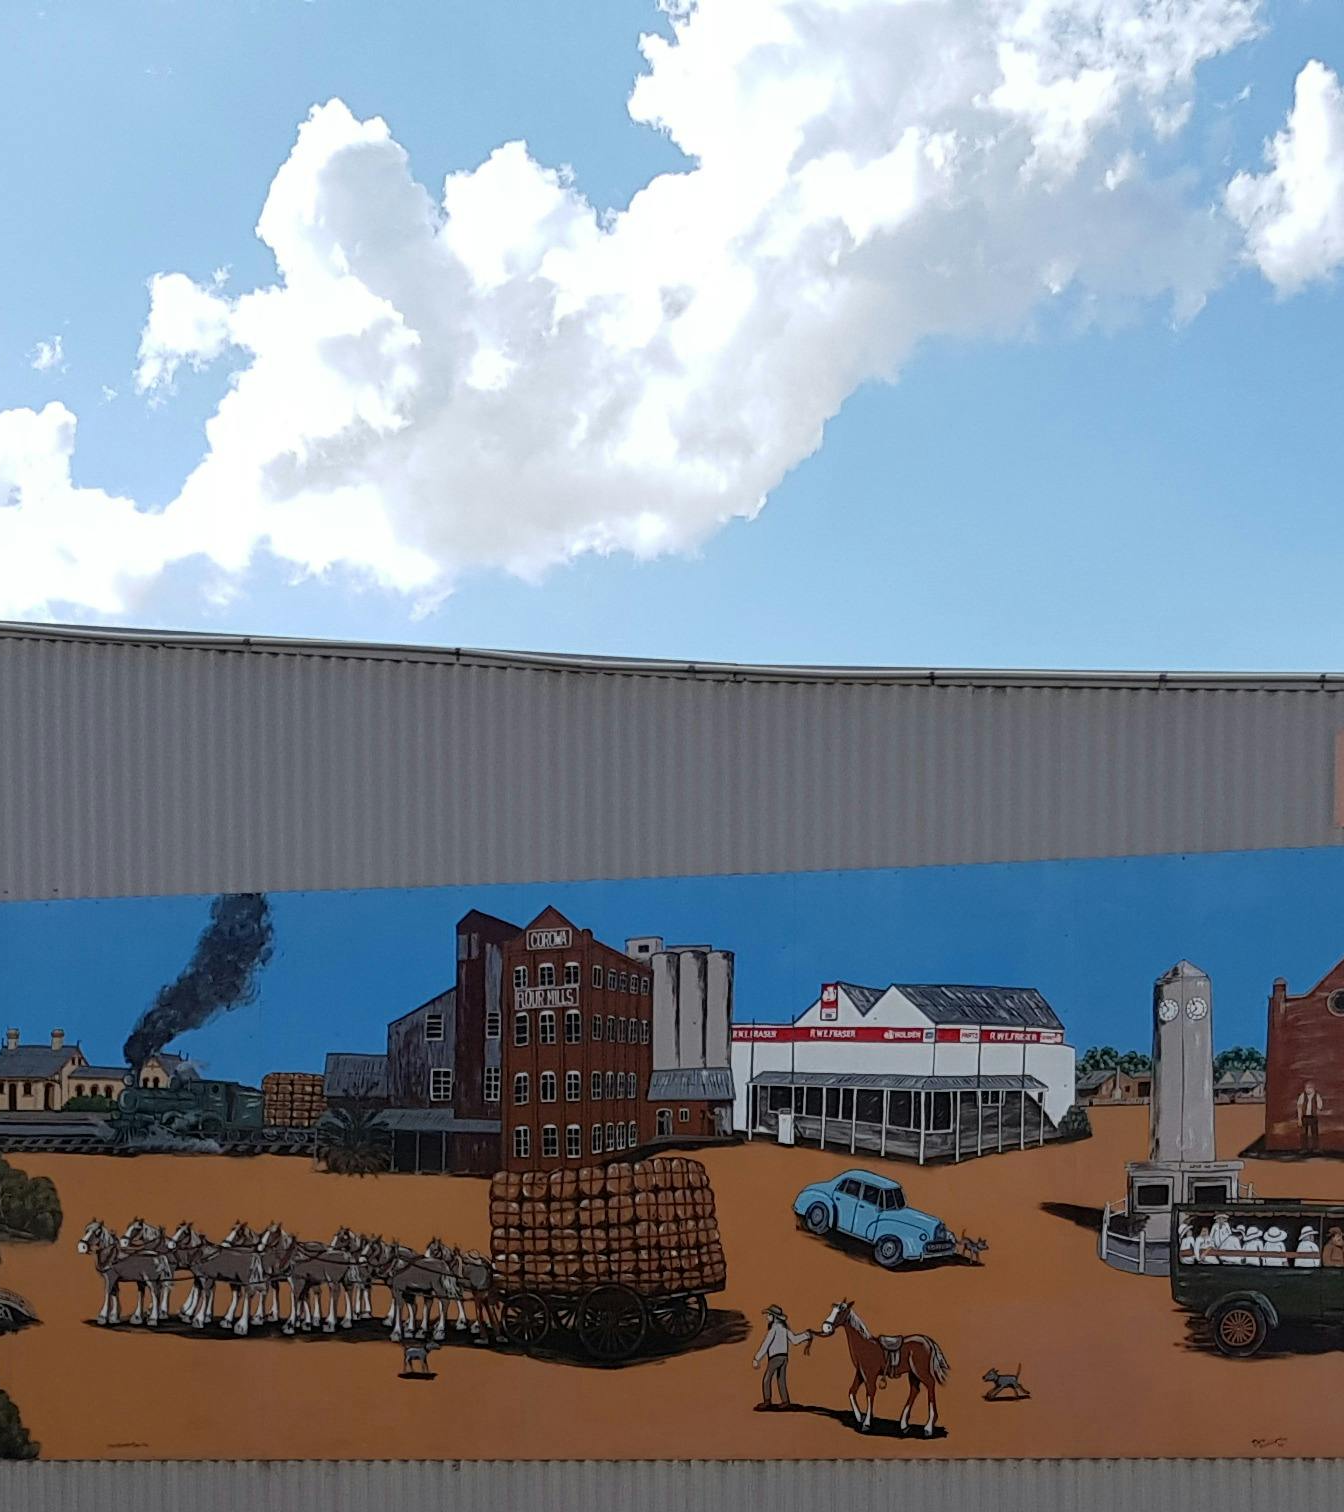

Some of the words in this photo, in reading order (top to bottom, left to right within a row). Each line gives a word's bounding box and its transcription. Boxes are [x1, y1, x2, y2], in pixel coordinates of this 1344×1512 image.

[530, 931, 568, 947] COROWA
[516, 990, 545, 1009] FLOUR
[546, 989, 574, 1006] MILLS
